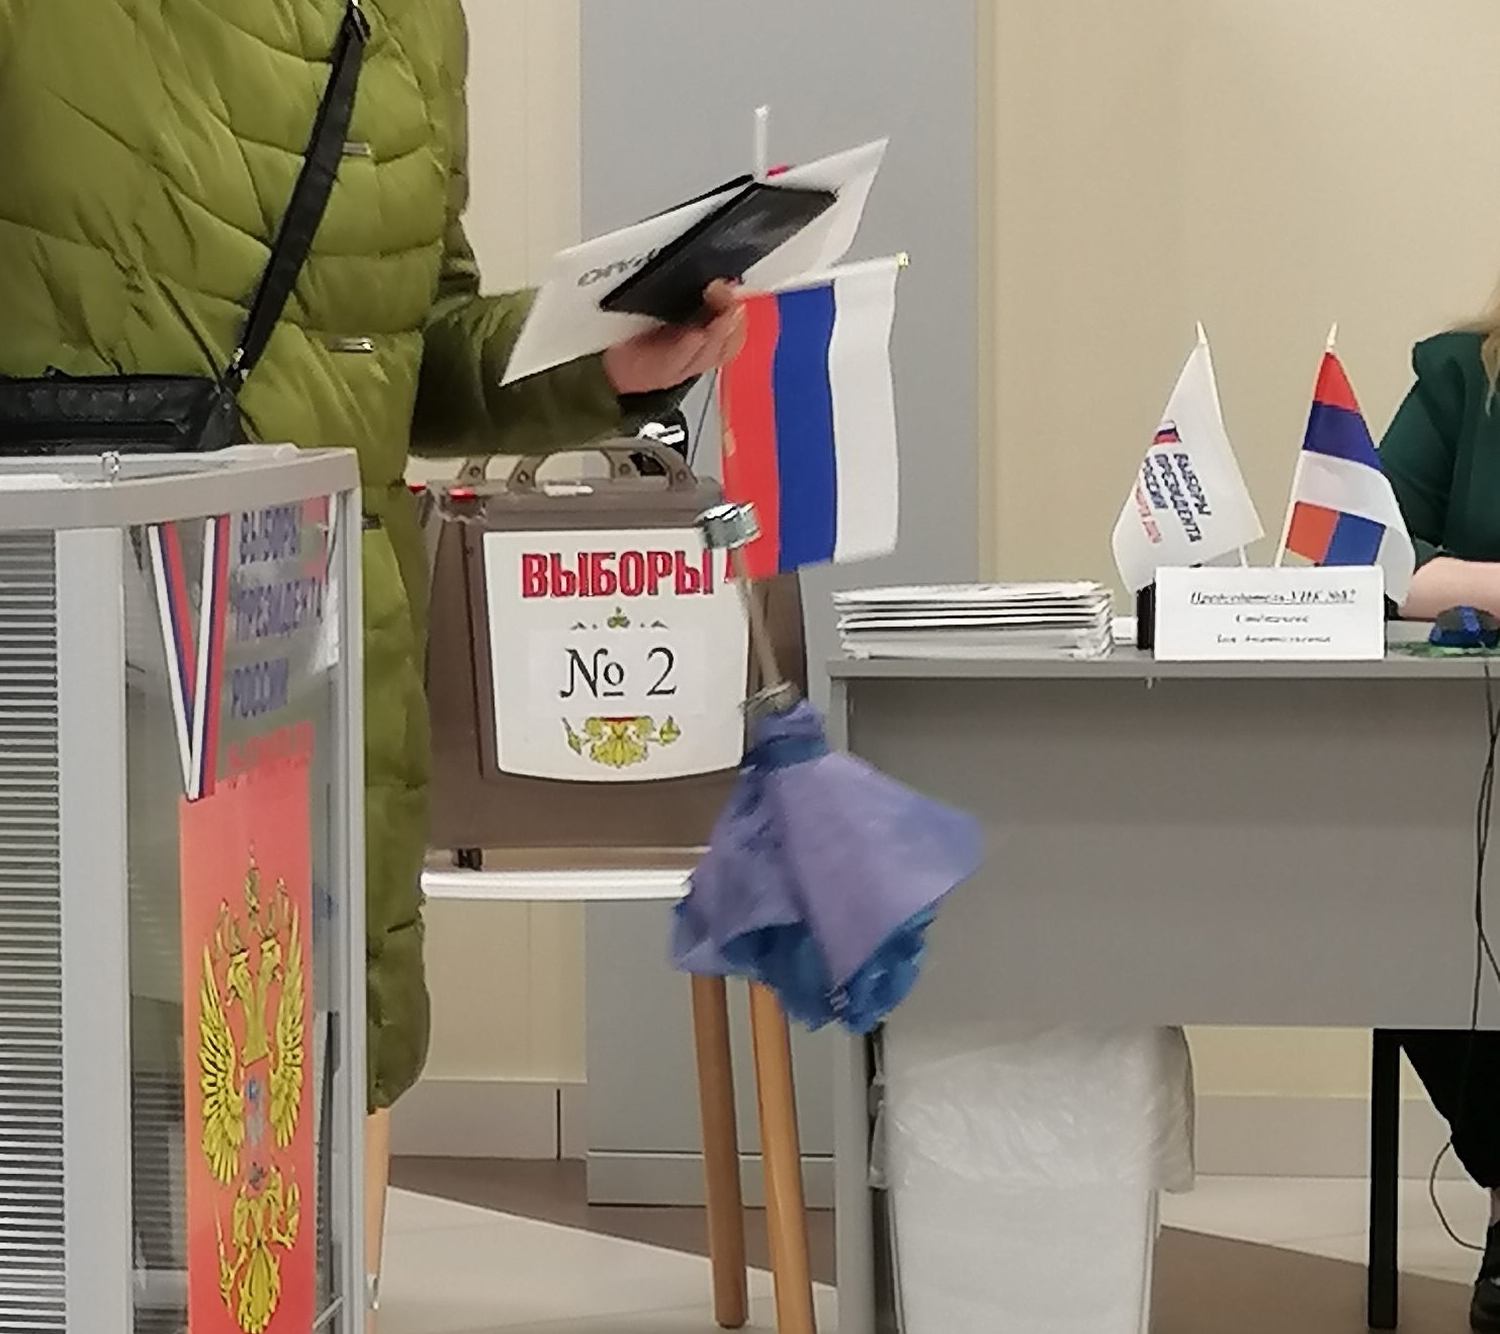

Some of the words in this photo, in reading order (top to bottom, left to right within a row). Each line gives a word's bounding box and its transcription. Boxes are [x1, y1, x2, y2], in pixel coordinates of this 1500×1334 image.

[522, 550, 714, 598] ВЫБОРЫ
[560, 646, 625, 698] №
[646, 646, 677, 697] 2
